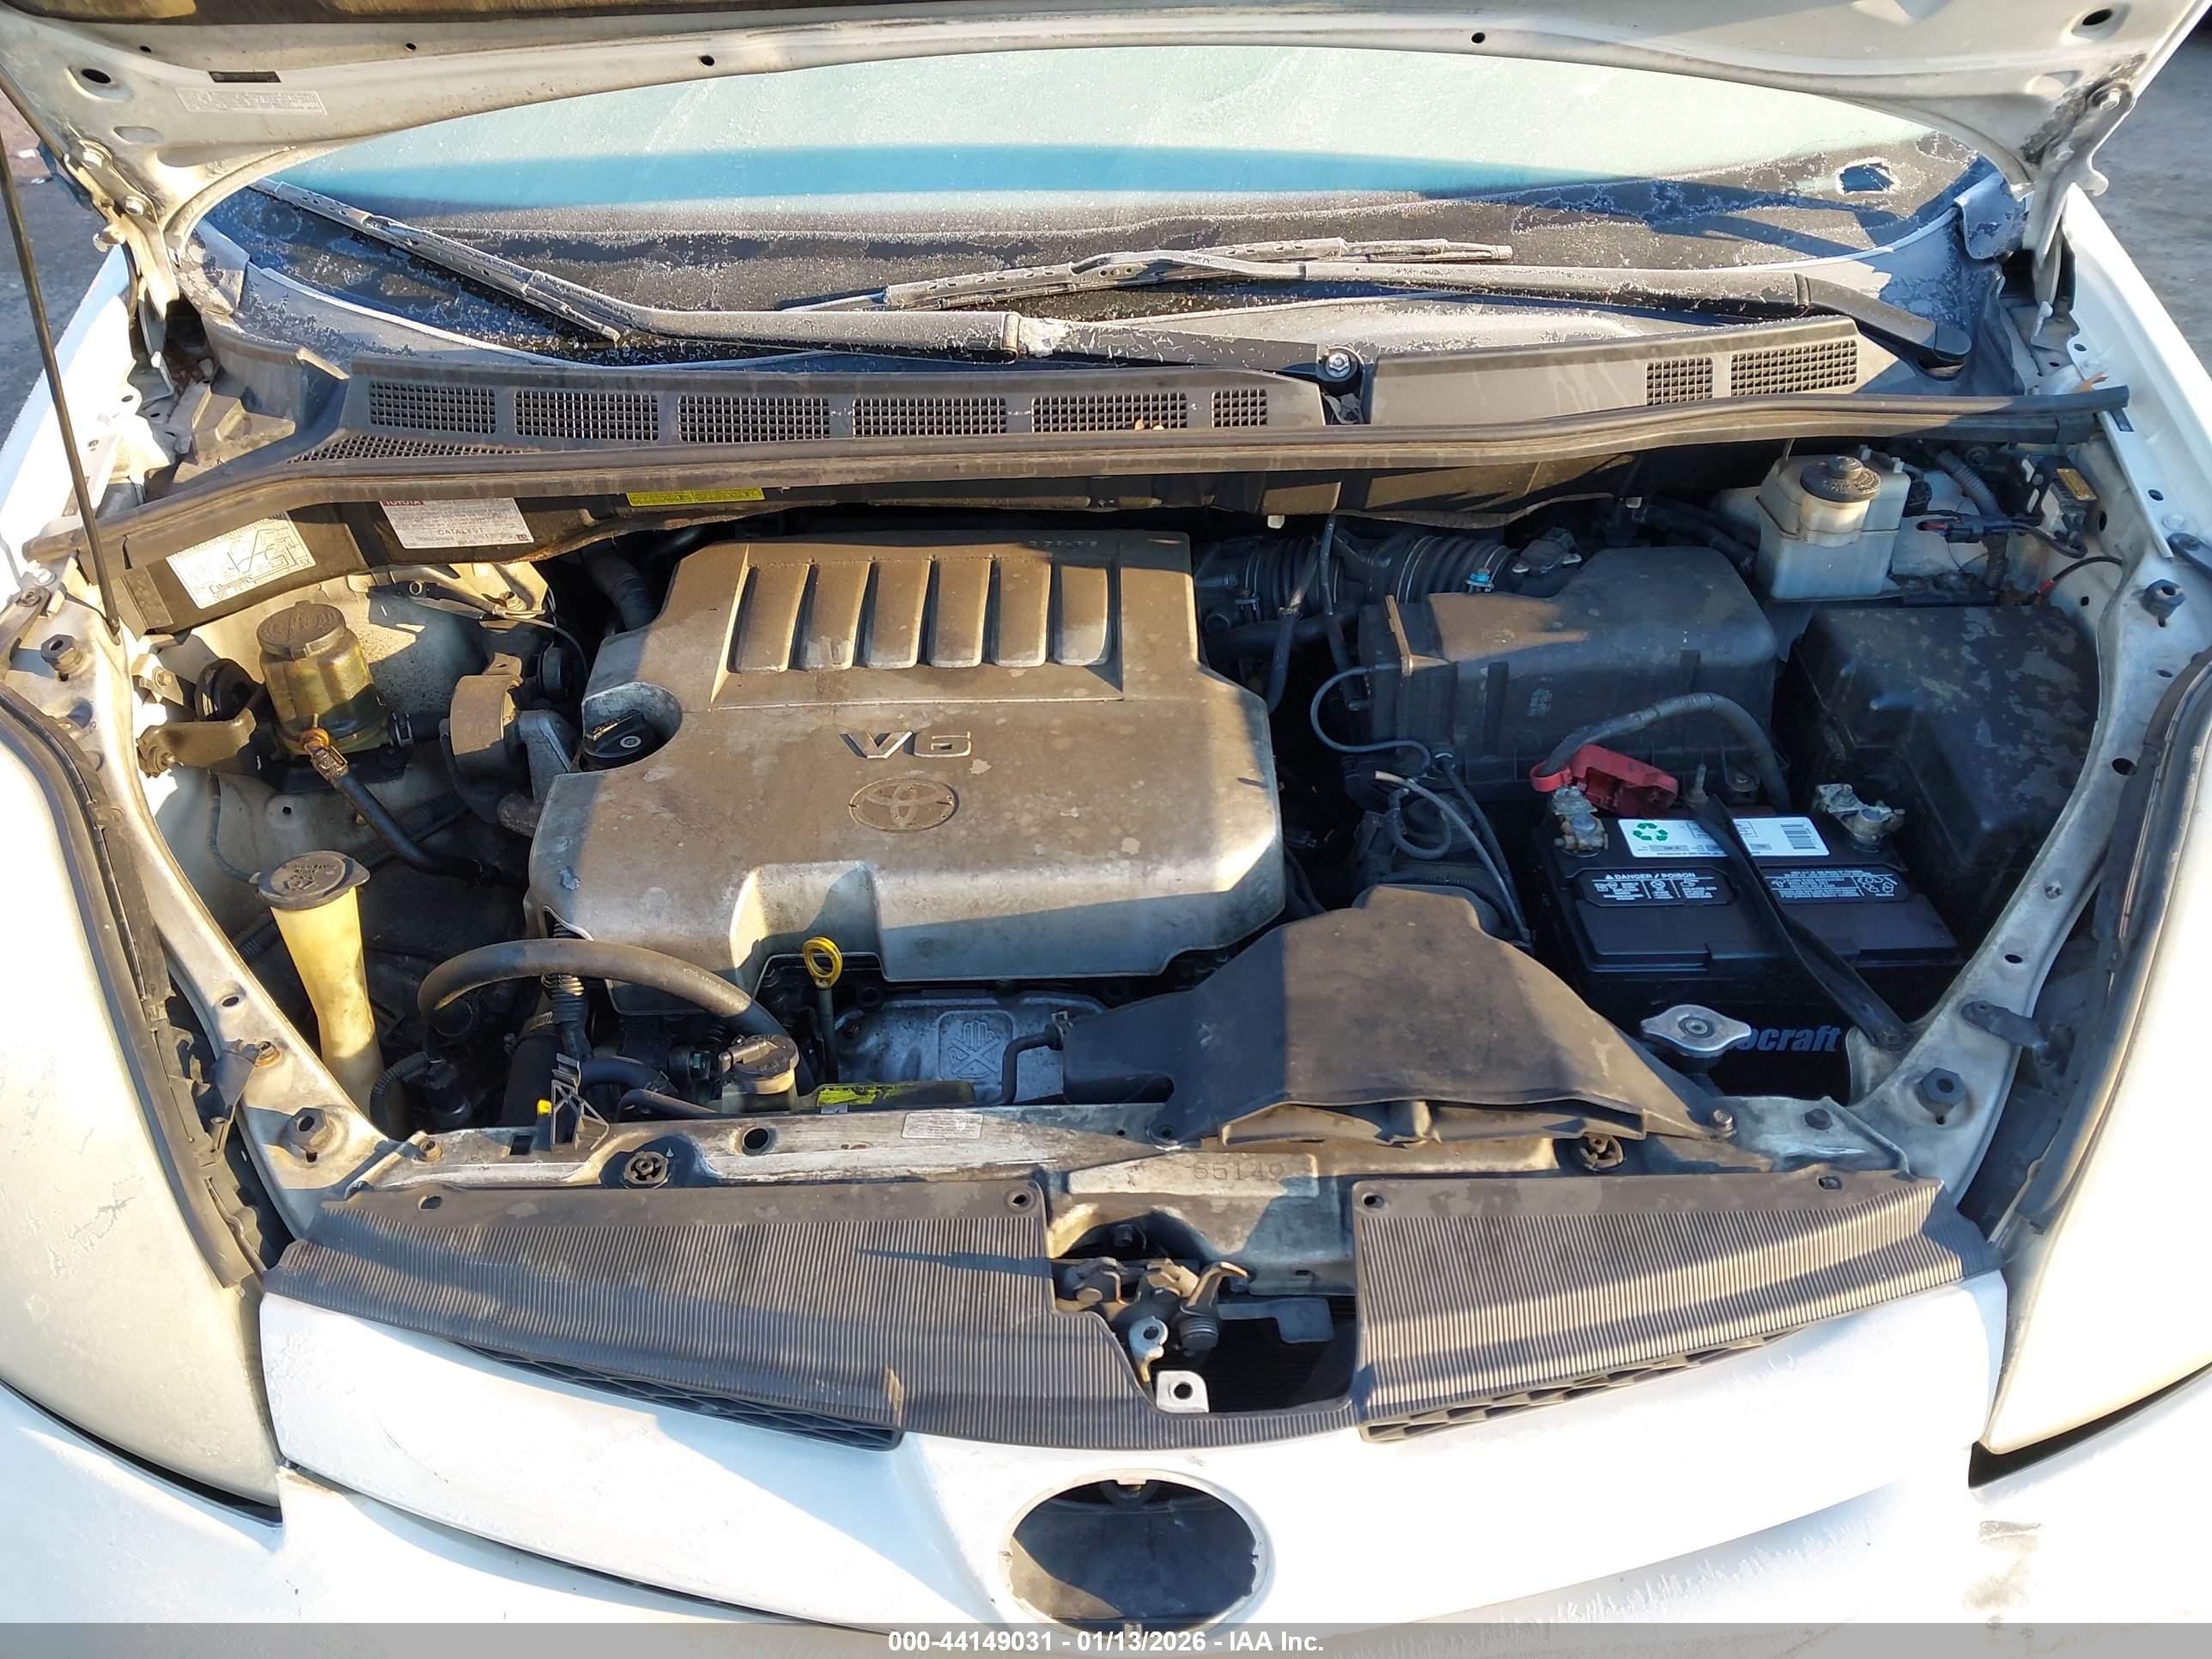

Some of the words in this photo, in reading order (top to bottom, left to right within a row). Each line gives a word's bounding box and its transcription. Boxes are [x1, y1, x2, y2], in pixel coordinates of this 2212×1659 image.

[437, 527, 484, 536] CATALYST
[838, 731, 971, 759] V6
[1194, 1161, 1284, 1181] 55149
